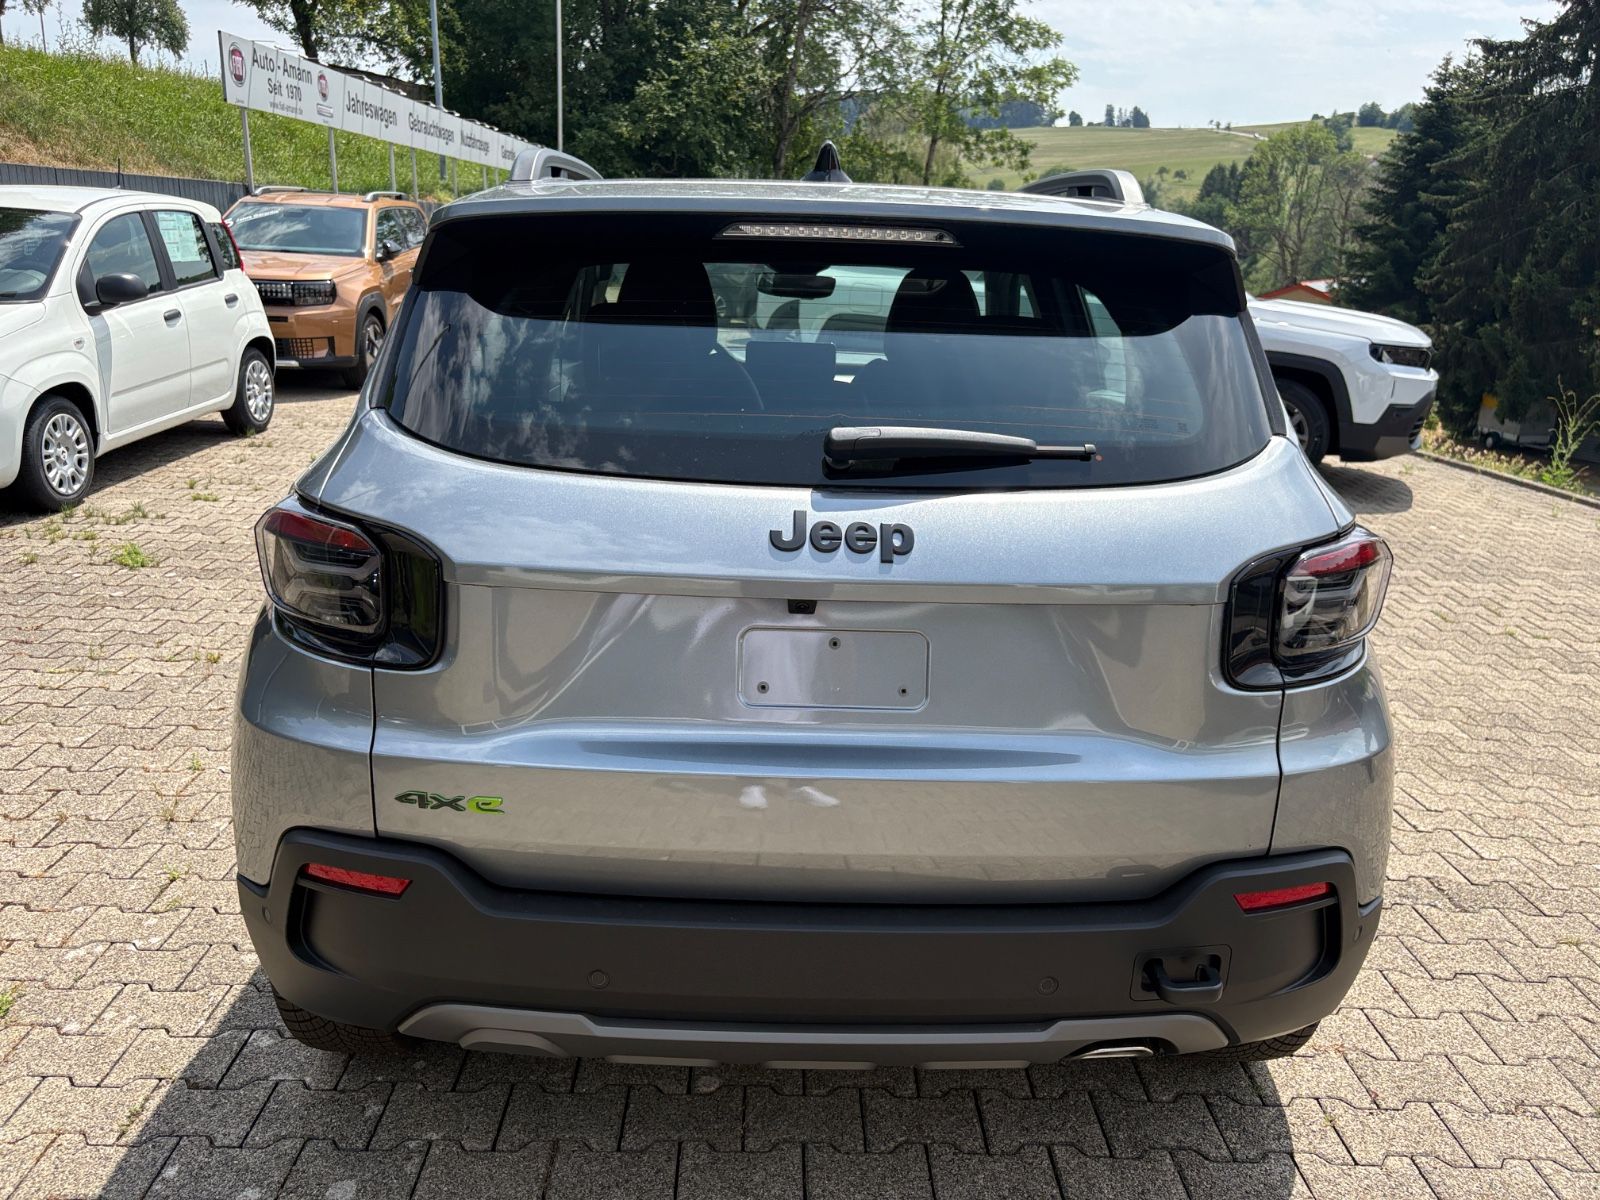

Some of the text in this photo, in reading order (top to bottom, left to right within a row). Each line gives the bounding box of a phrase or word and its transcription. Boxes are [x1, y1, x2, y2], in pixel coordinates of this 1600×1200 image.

[253, 48, 275, 72] Auto
[283, 58, 312, 85] Amann
[267, 78, 302, 102] Seit 1970
[346, 91, 398, 128] Jahreswagen
[408, 112, 455, 145] Gebrauchtwagen
[769, 510, 915, 563] Jeep
